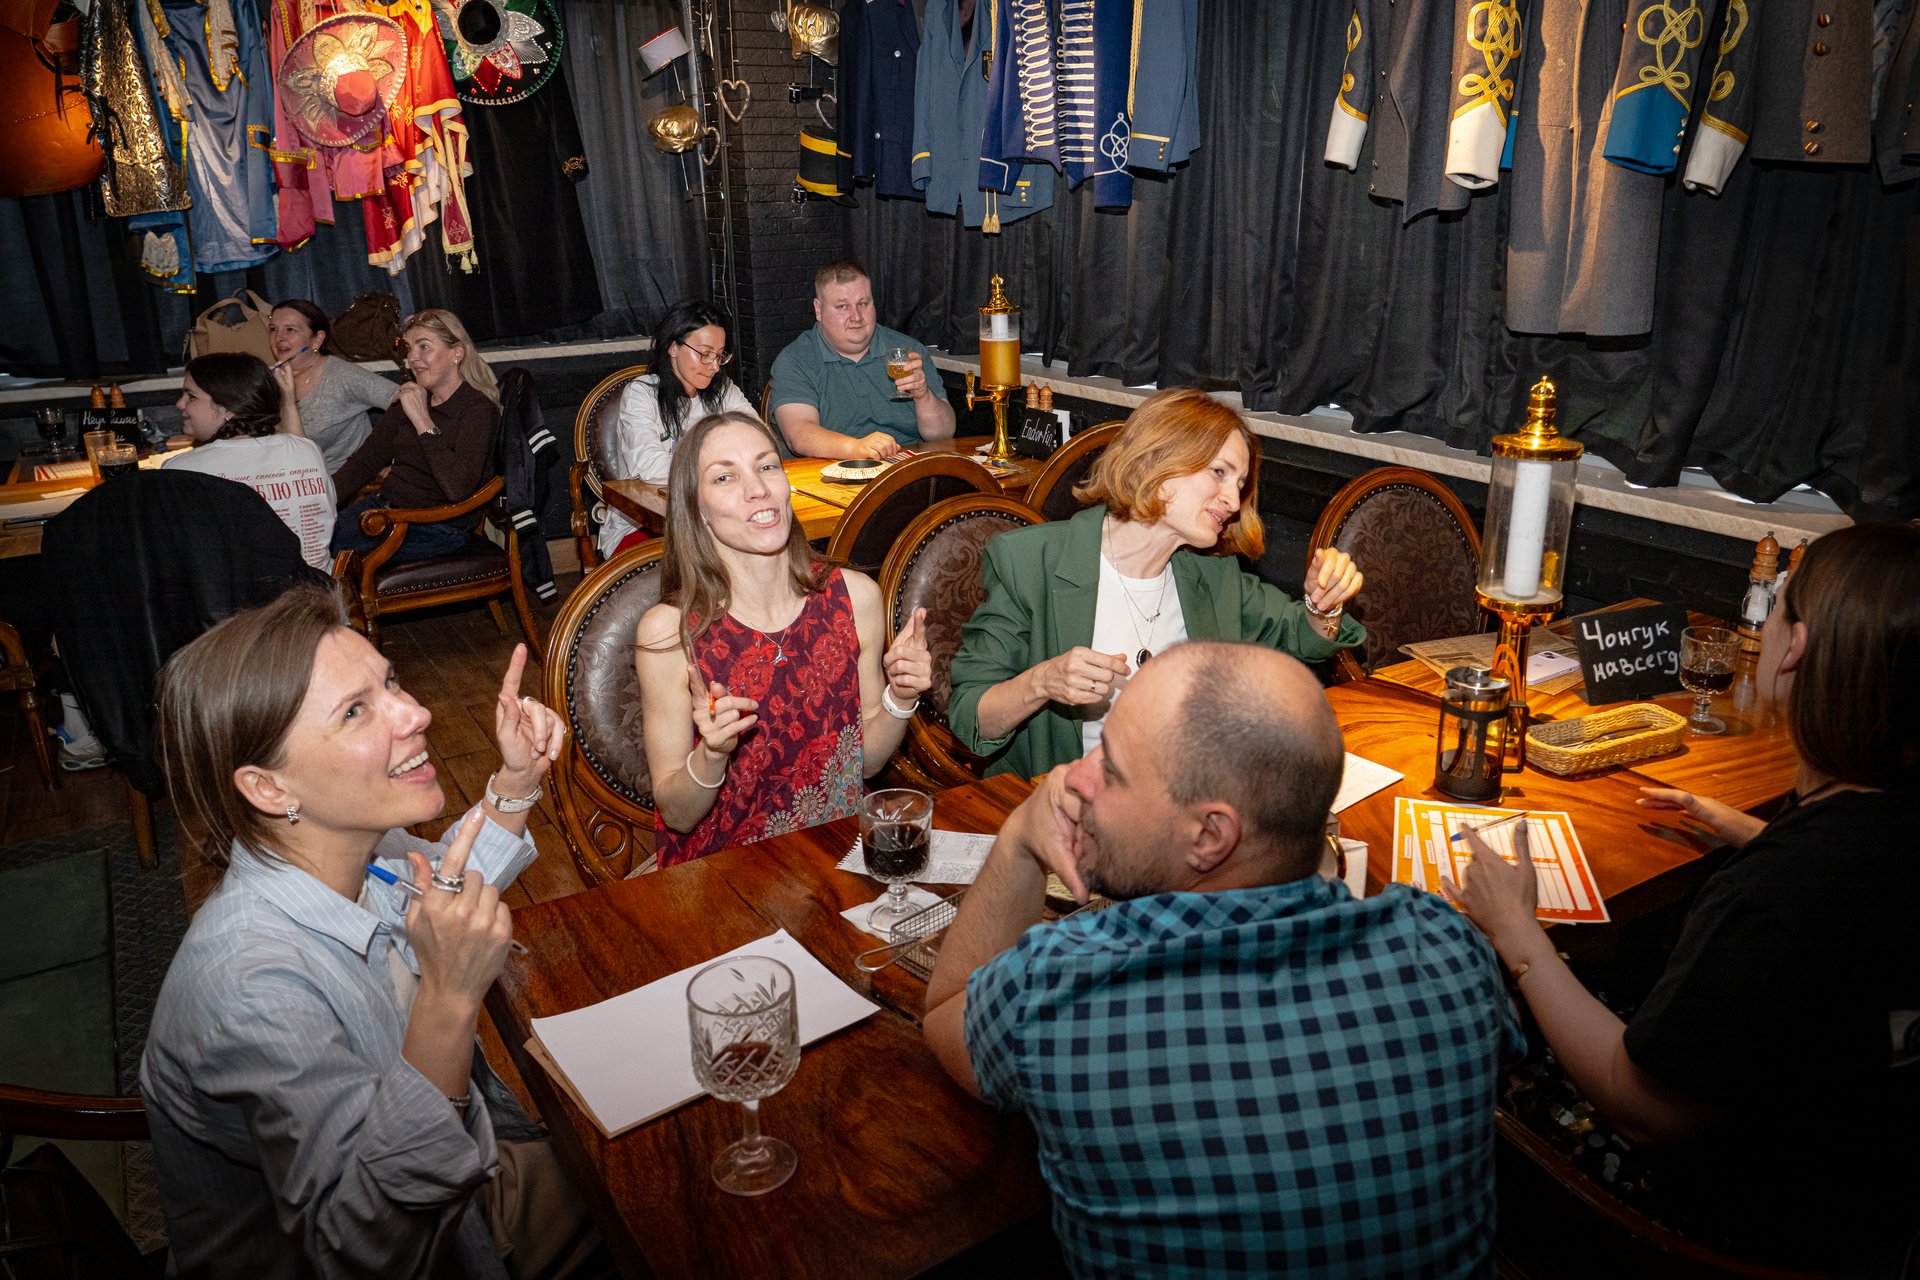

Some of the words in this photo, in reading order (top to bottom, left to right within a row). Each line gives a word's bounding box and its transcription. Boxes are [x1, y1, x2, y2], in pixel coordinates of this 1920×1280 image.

[252, 482, 292, 501] БЛЮ
[292, 477, 326, 497] ТЕБЯ
[1581, 619, 1670, 651] Чонгук
[1592, 650, 1681, 683] навсегд
